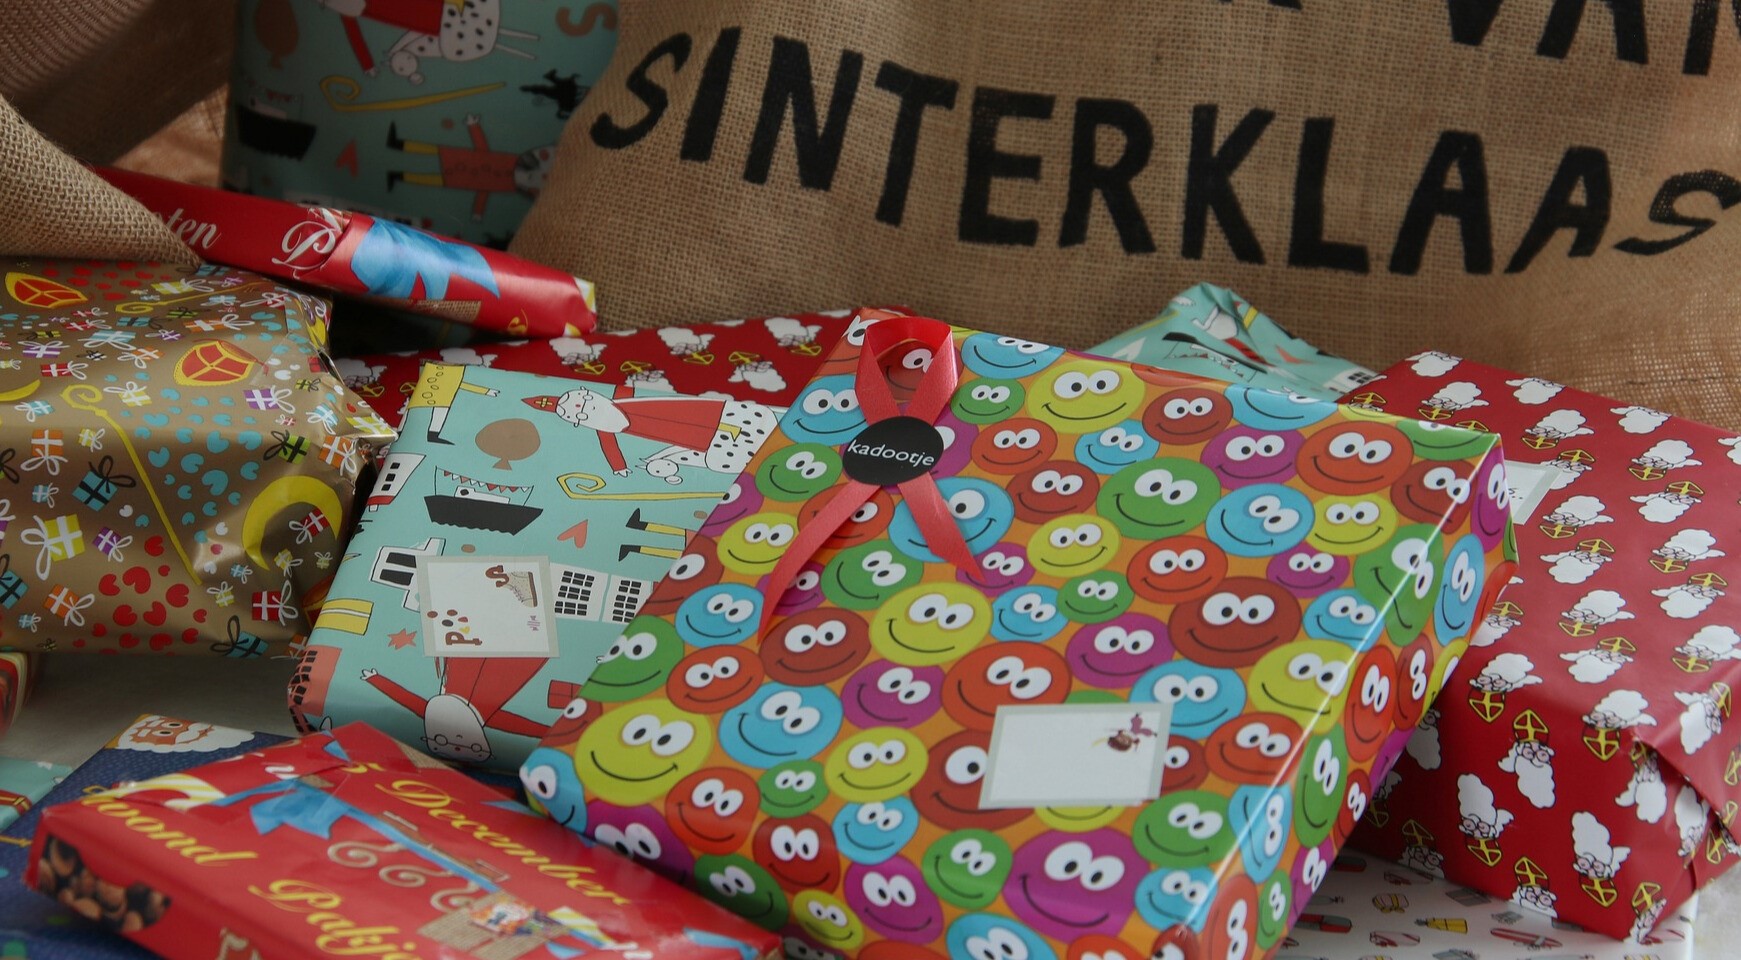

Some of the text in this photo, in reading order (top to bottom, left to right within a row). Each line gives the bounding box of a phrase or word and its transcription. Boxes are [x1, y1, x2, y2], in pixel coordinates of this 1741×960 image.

[589, 27, 1741, 276] SINTERKLAAS
[847, 439, 935, 467] kadootje
[375, 780, 631, 905] December
